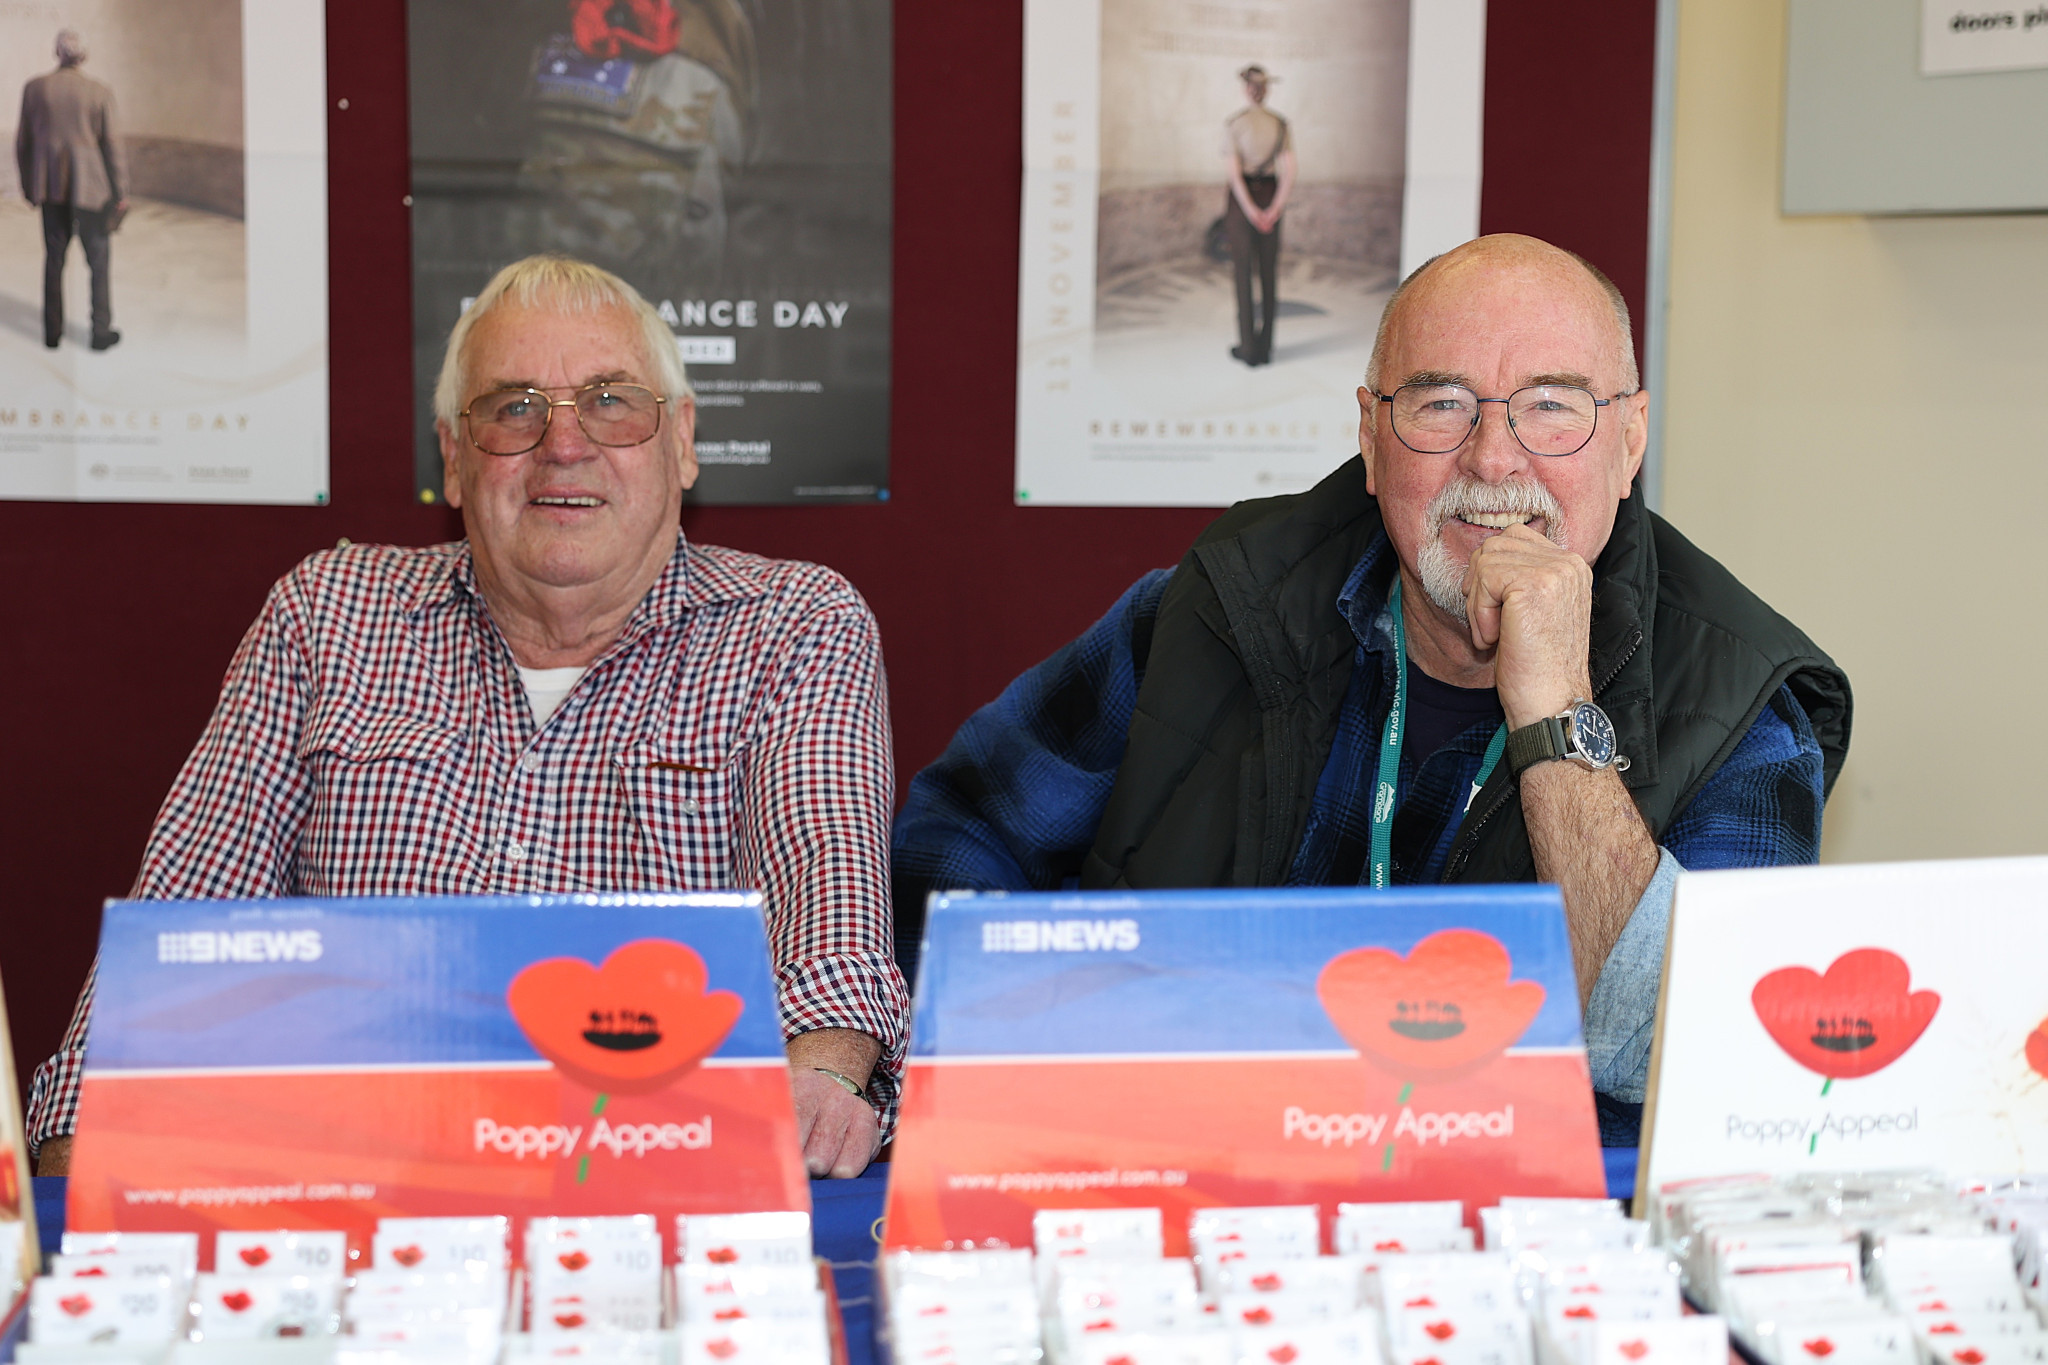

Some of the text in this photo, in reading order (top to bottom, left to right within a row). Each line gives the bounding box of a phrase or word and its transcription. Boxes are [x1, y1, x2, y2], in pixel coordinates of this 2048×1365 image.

[1951, 10, 2015, 32] doors
[1049, 103, 1077, 327] NOVEMBER
[773, 300, 850, 329] DAY
[186, 411, 248, 432] DAY
[1089, 419, 1320, 438] REMEMBRANCE
[474, 1114, 713, 1160] Poppy Appeal
[1283, 1104, 1514, 1148] Poppy Appeal
[1727, 1105, 1919, 1146] Poppy Appeal
[948, 1167, 1188, 1193] www.poppyappeal.com.au
[124, 1182, 376, 1208] www.poppyappeal.com.au
